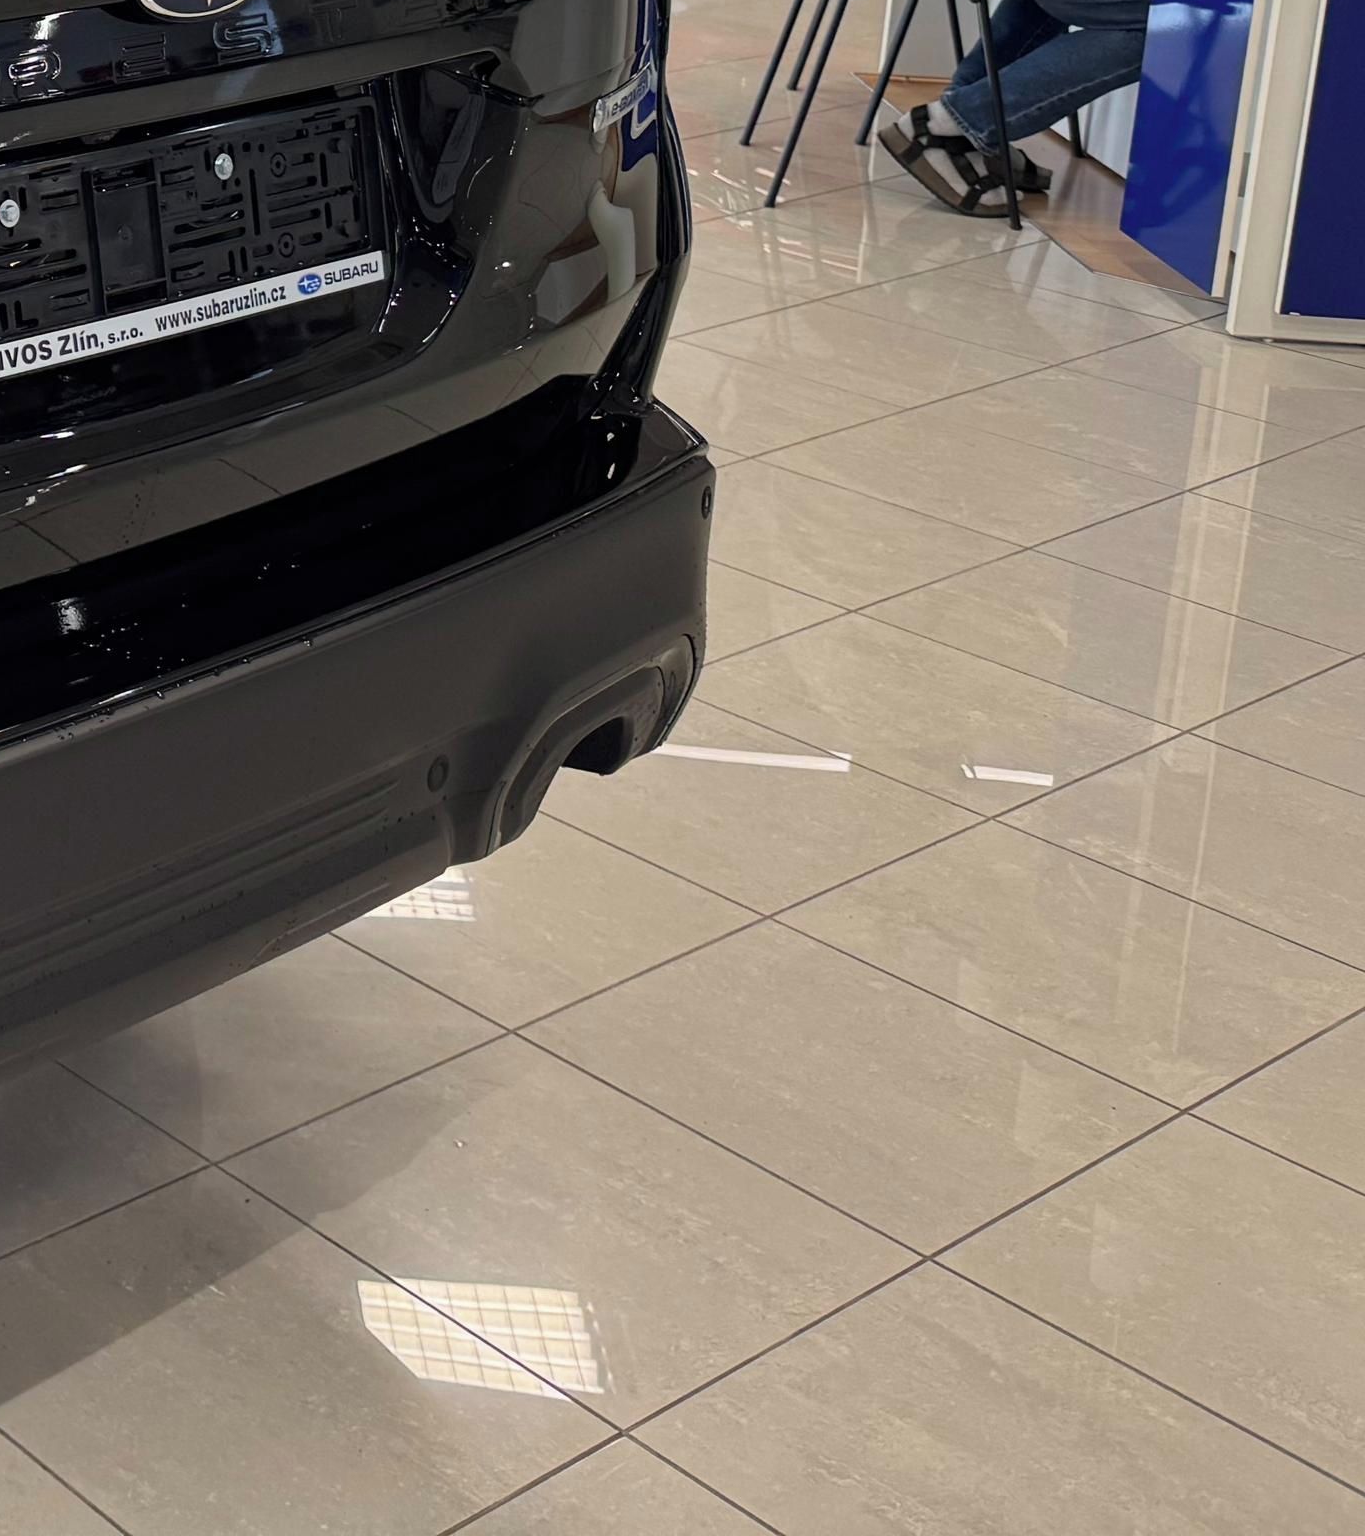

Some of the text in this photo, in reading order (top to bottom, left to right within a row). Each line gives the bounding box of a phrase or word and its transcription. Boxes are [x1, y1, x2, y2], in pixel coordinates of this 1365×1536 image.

[57, 330, 105, 357] Zlín,
[107, 327, 144, 345] s.r.o.
[154, 284, 287, 333] www.subaruzlin.cz
[323, 260, 379, 287] SUBARU
